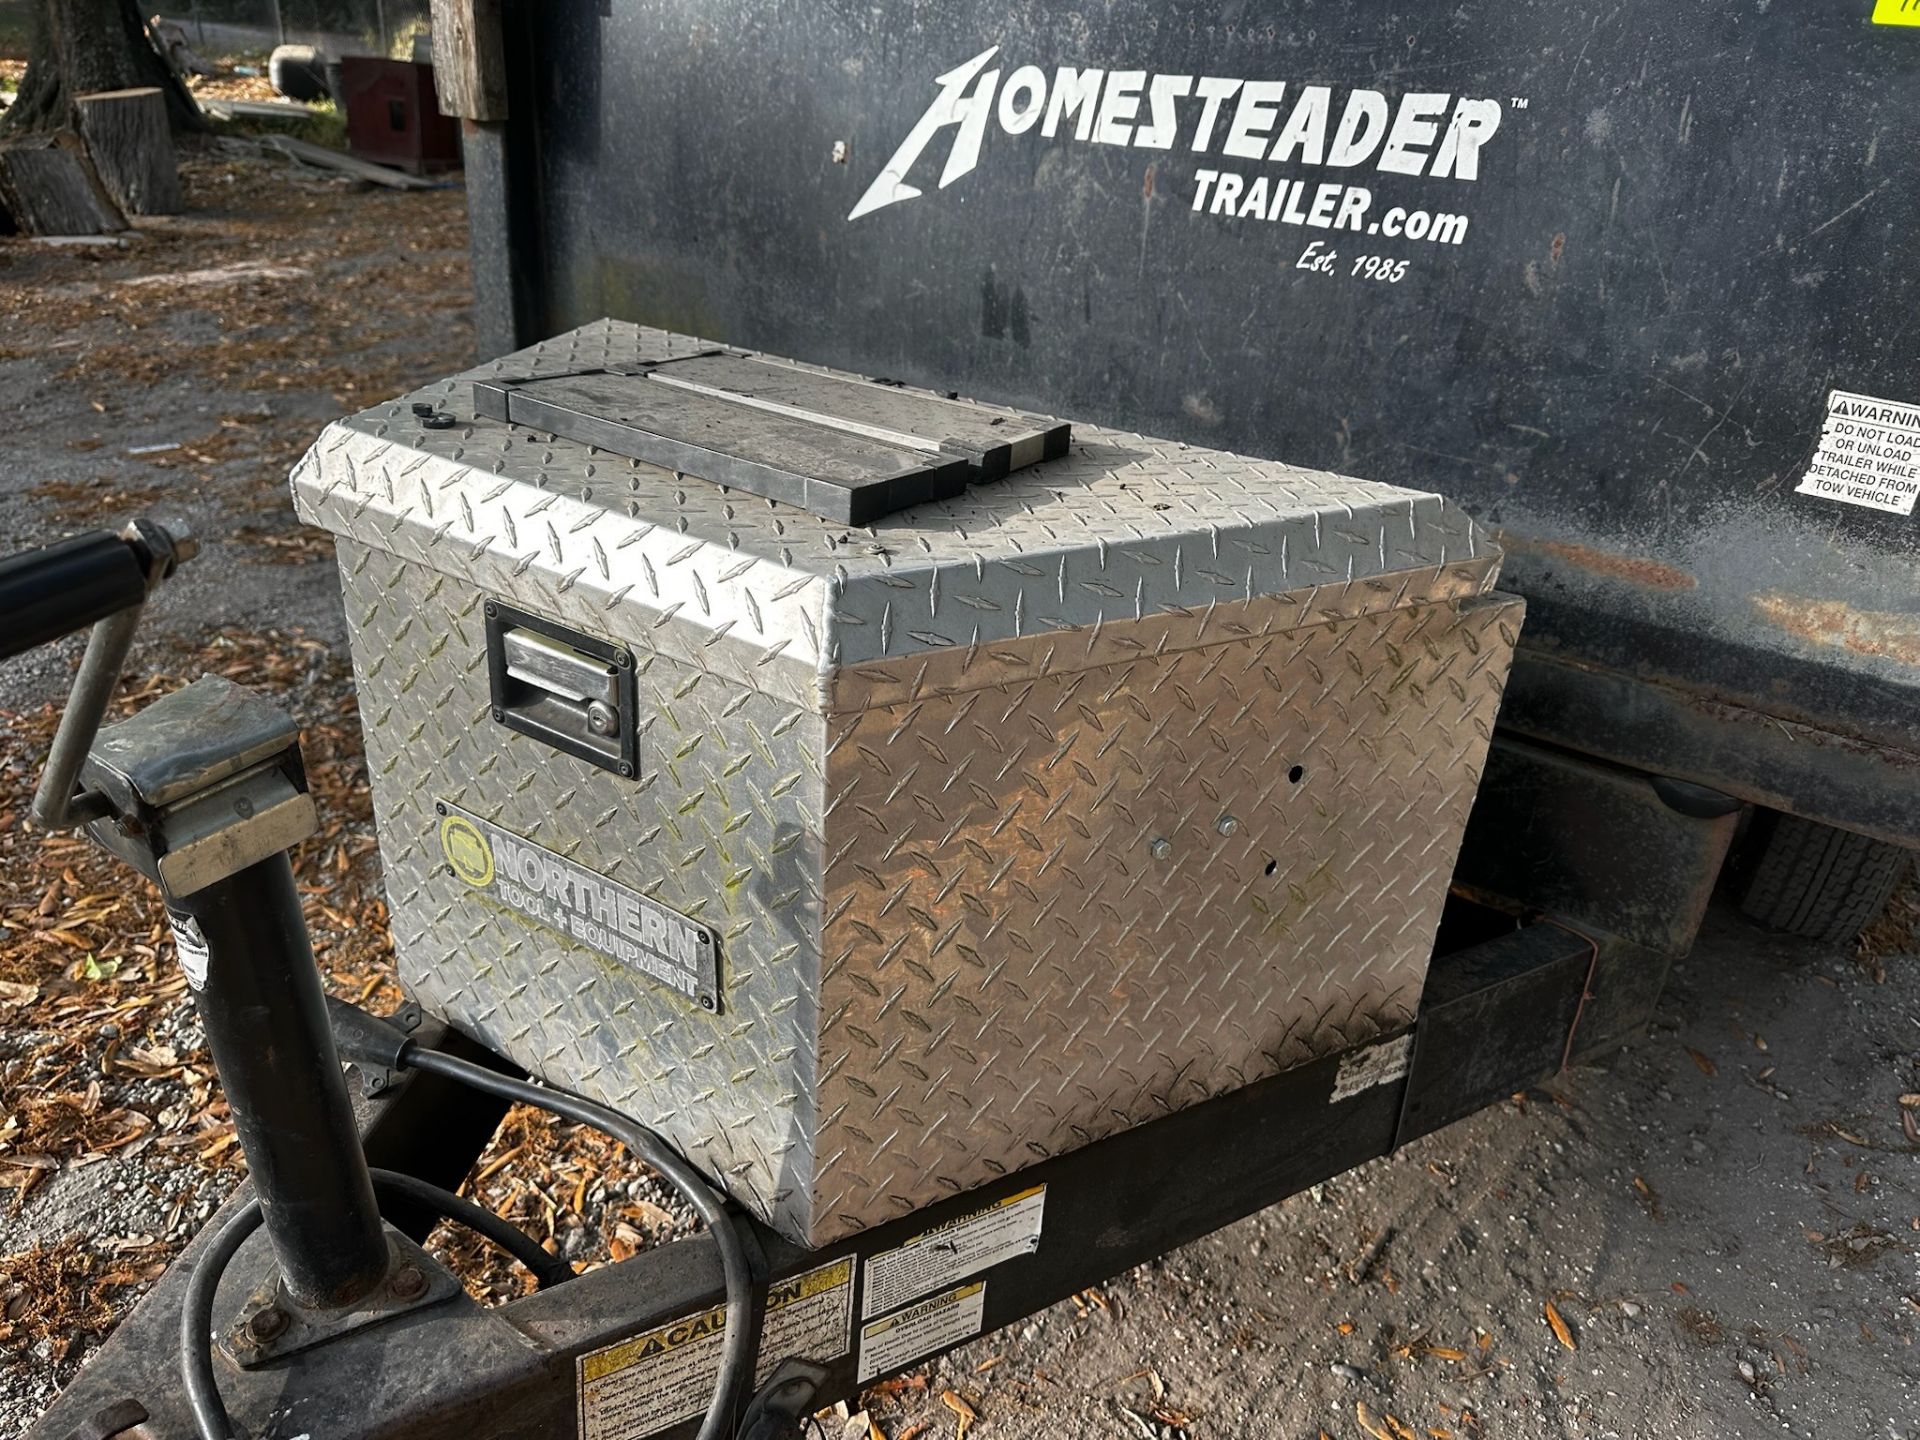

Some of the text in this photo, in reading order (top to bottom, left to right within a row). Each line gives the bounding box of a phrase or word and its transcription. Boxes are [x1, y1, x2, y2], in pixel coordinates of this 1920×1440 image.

[848, 45, 1503, 222] HOMESTEADER
[1191, 169, 1469, 245] TRAILER.com
[1296, 241, 1410, 284] Est. 1985
[1850, 403, 1920, 429] WARNIN
[1834, 422, 1920, 449] DO NOT LOAD
[1835, 438, 1912, 462] OR UNLOAD
[1808, 464, 1917, 494] DETACHED FROM
[1820, 450, 1918, 479] TRAILER WHILE
[1815, 479, 1901, 506] TOW VEHICLE
[490, 832, 698, 971] NORTHERN
[496, 878, 550, 922] TOOL
[570, 914, 698, 997] EQUIPMENT
[667, 1282, 801, 1348] CAUON
[901, 1292, 956, 1322] WARNING
